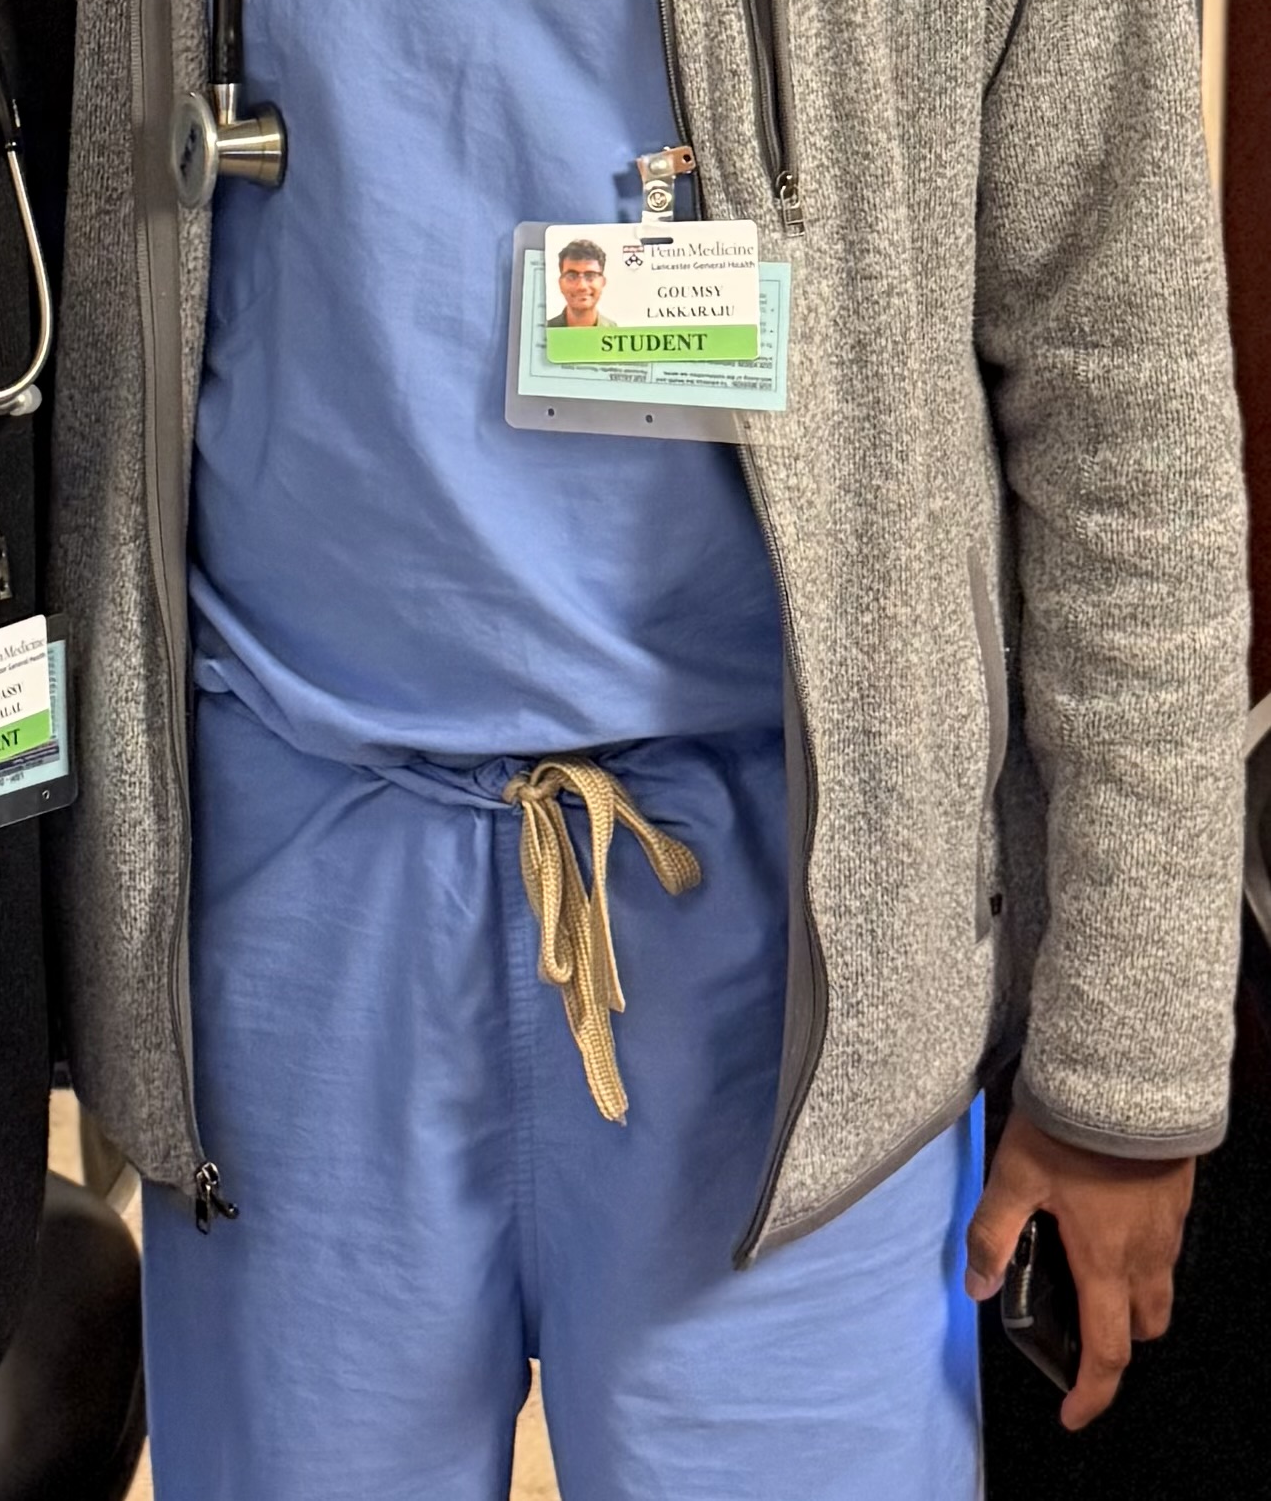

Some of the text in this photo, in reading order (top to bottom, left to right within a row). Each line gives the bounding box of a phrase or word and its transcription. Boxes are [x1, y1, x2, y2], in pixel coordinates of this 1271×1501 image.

[688, 240, 755, 257] Medicine
[657, 285, 724, 299] GOUMSY
[646, 304, 735, 319] LAKKARAJU
[600, 332, 709, 353] STUDENT
